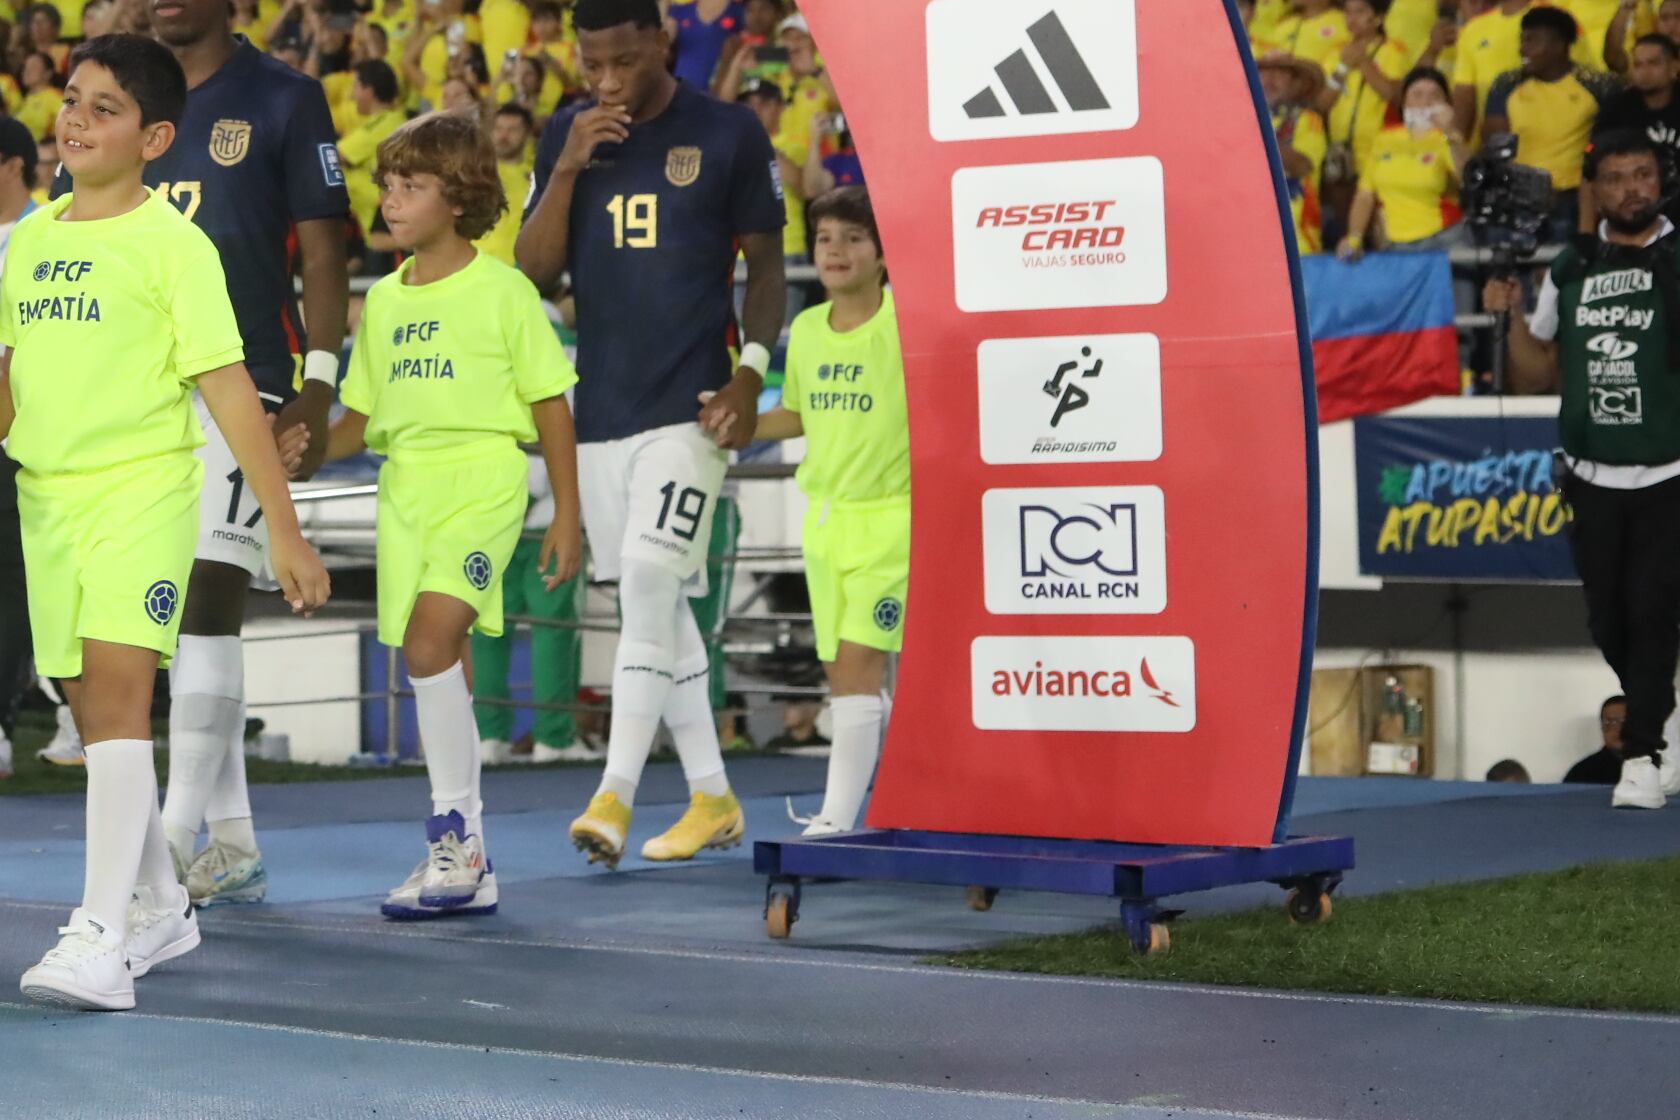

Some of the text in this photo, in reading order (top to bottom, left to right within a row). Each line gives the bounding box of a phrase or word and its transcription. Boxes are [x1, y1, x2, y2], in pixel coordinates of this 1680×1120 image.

[606, 193, 657, 248] 19
[976, 200, 1116, 228] ASSIST
[1022, 226, 1125, 251] CARD
[51, 260, 93, 282] FCF
[1022, 252, 1126, 268] VIAJAS SEGURO
[18, 291, 101, 325] EMPATÍA
[1576, 304, 1655, 330] BetPlay
[406, 321, 440, 343] FCF
[1031, 441, 1117, 453] RAPIDISIMO
[656, 481, 707, 542] 19
[1021, 582, 1140, 599] CANAL RCN
[991, 661, 1131, 697] avianca
